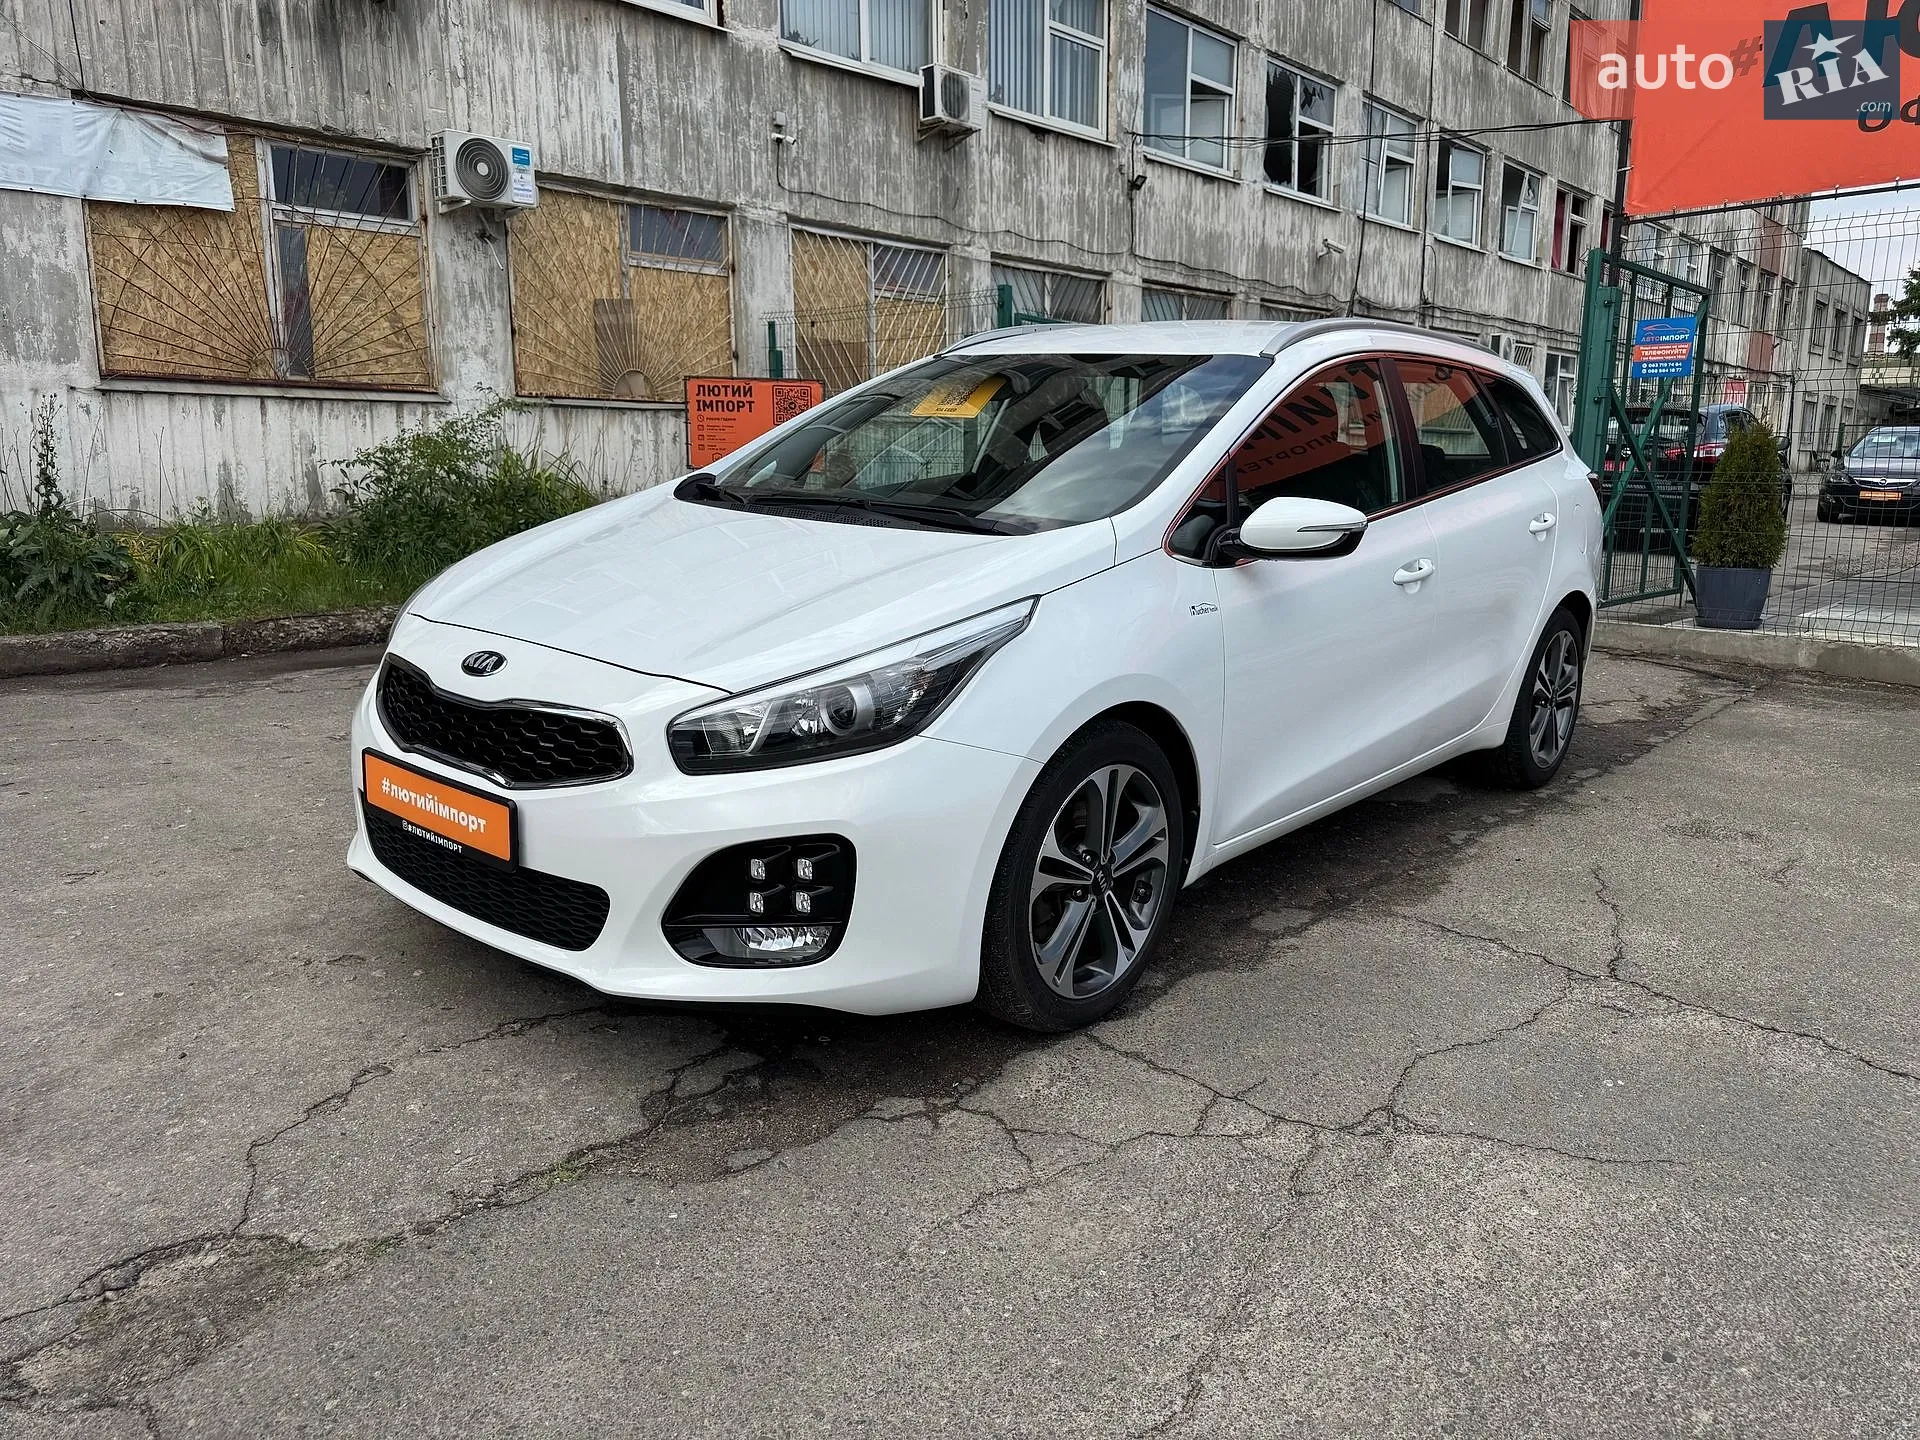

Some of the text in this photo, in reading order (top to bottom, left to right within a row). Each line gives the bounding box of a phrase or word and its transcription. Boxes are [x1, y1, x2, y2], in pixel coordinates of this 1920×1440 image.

[695, 382, 753, 398] ЛЮТИЙ
[695, 399, 755, 413] ІМПОРТ
[464, 653, 498, 671] KIA
[381, 777, 488, 834] #лютийімпорт
[1097, 870, 1106, 892] KIA
